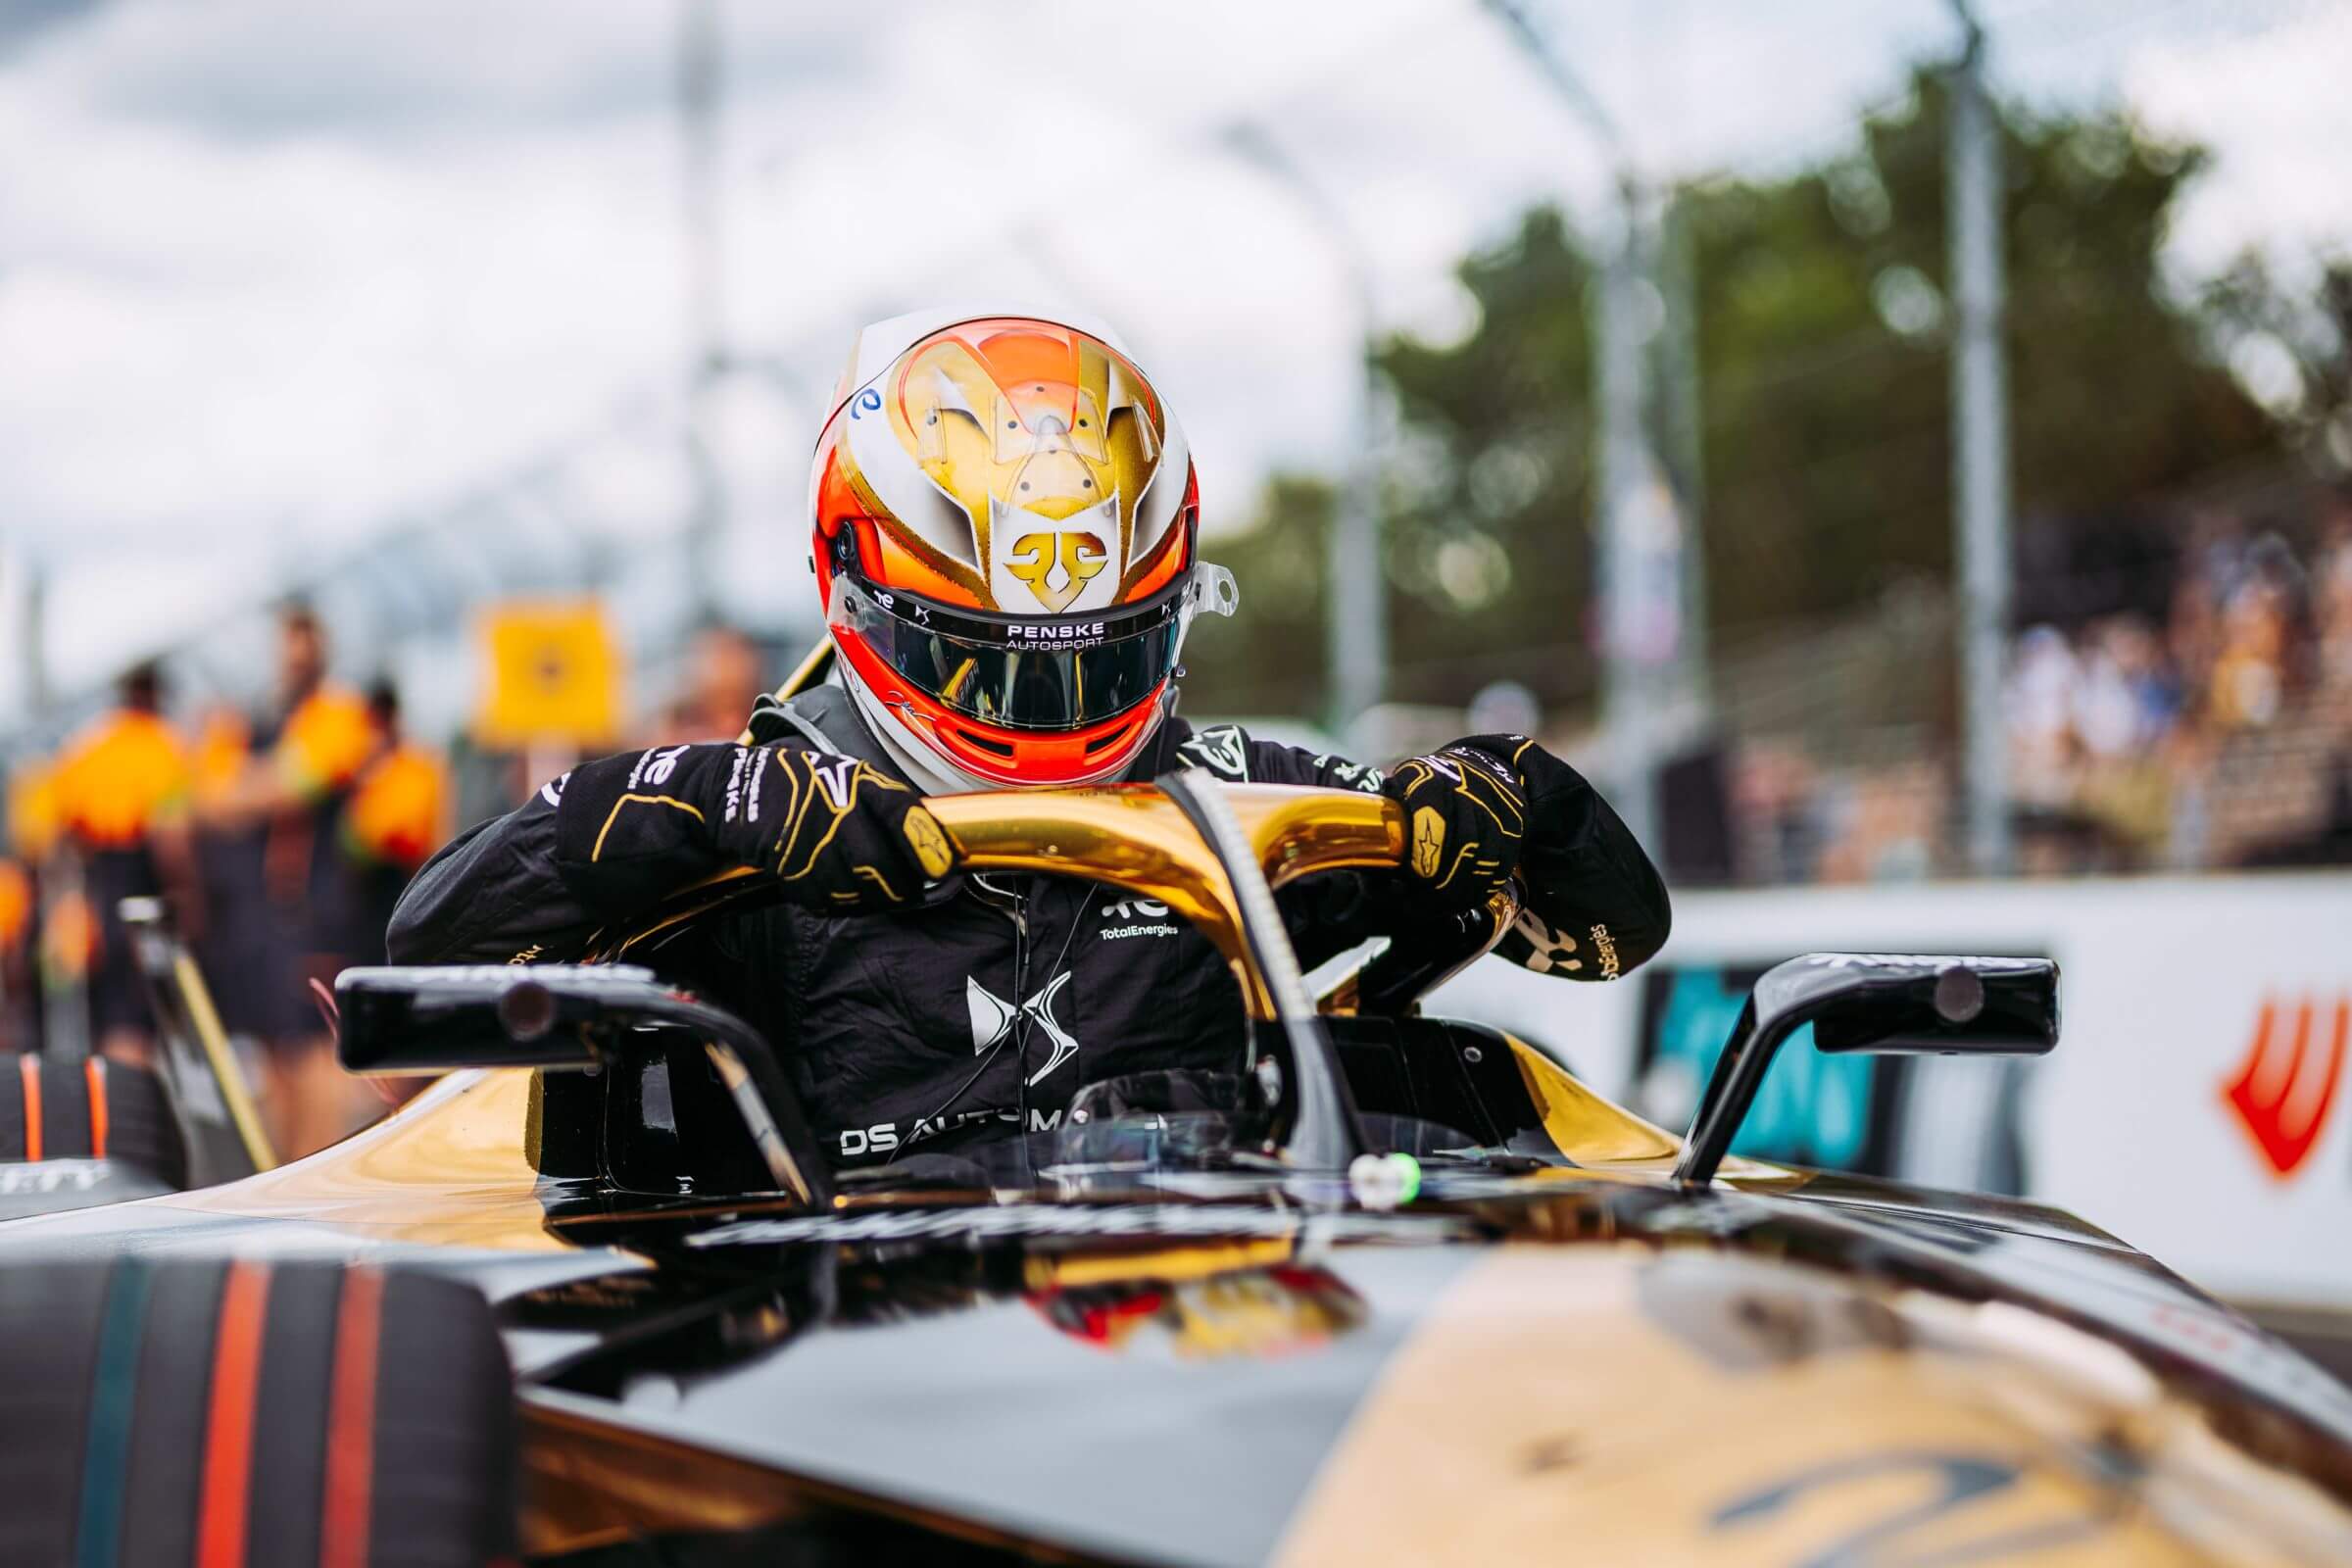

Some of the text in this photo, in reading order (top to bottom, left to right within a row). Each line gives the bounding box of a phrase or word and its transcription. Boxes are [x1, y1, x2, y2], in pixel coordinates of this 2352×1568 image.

[1006, 622, 1104, 639] PENSKE
[1006, 637, 1104, 652] AUTOSPORT
[1100, 923, 1178, 941] TotalEnergies
[840, 1123, 899, 1156] DS
